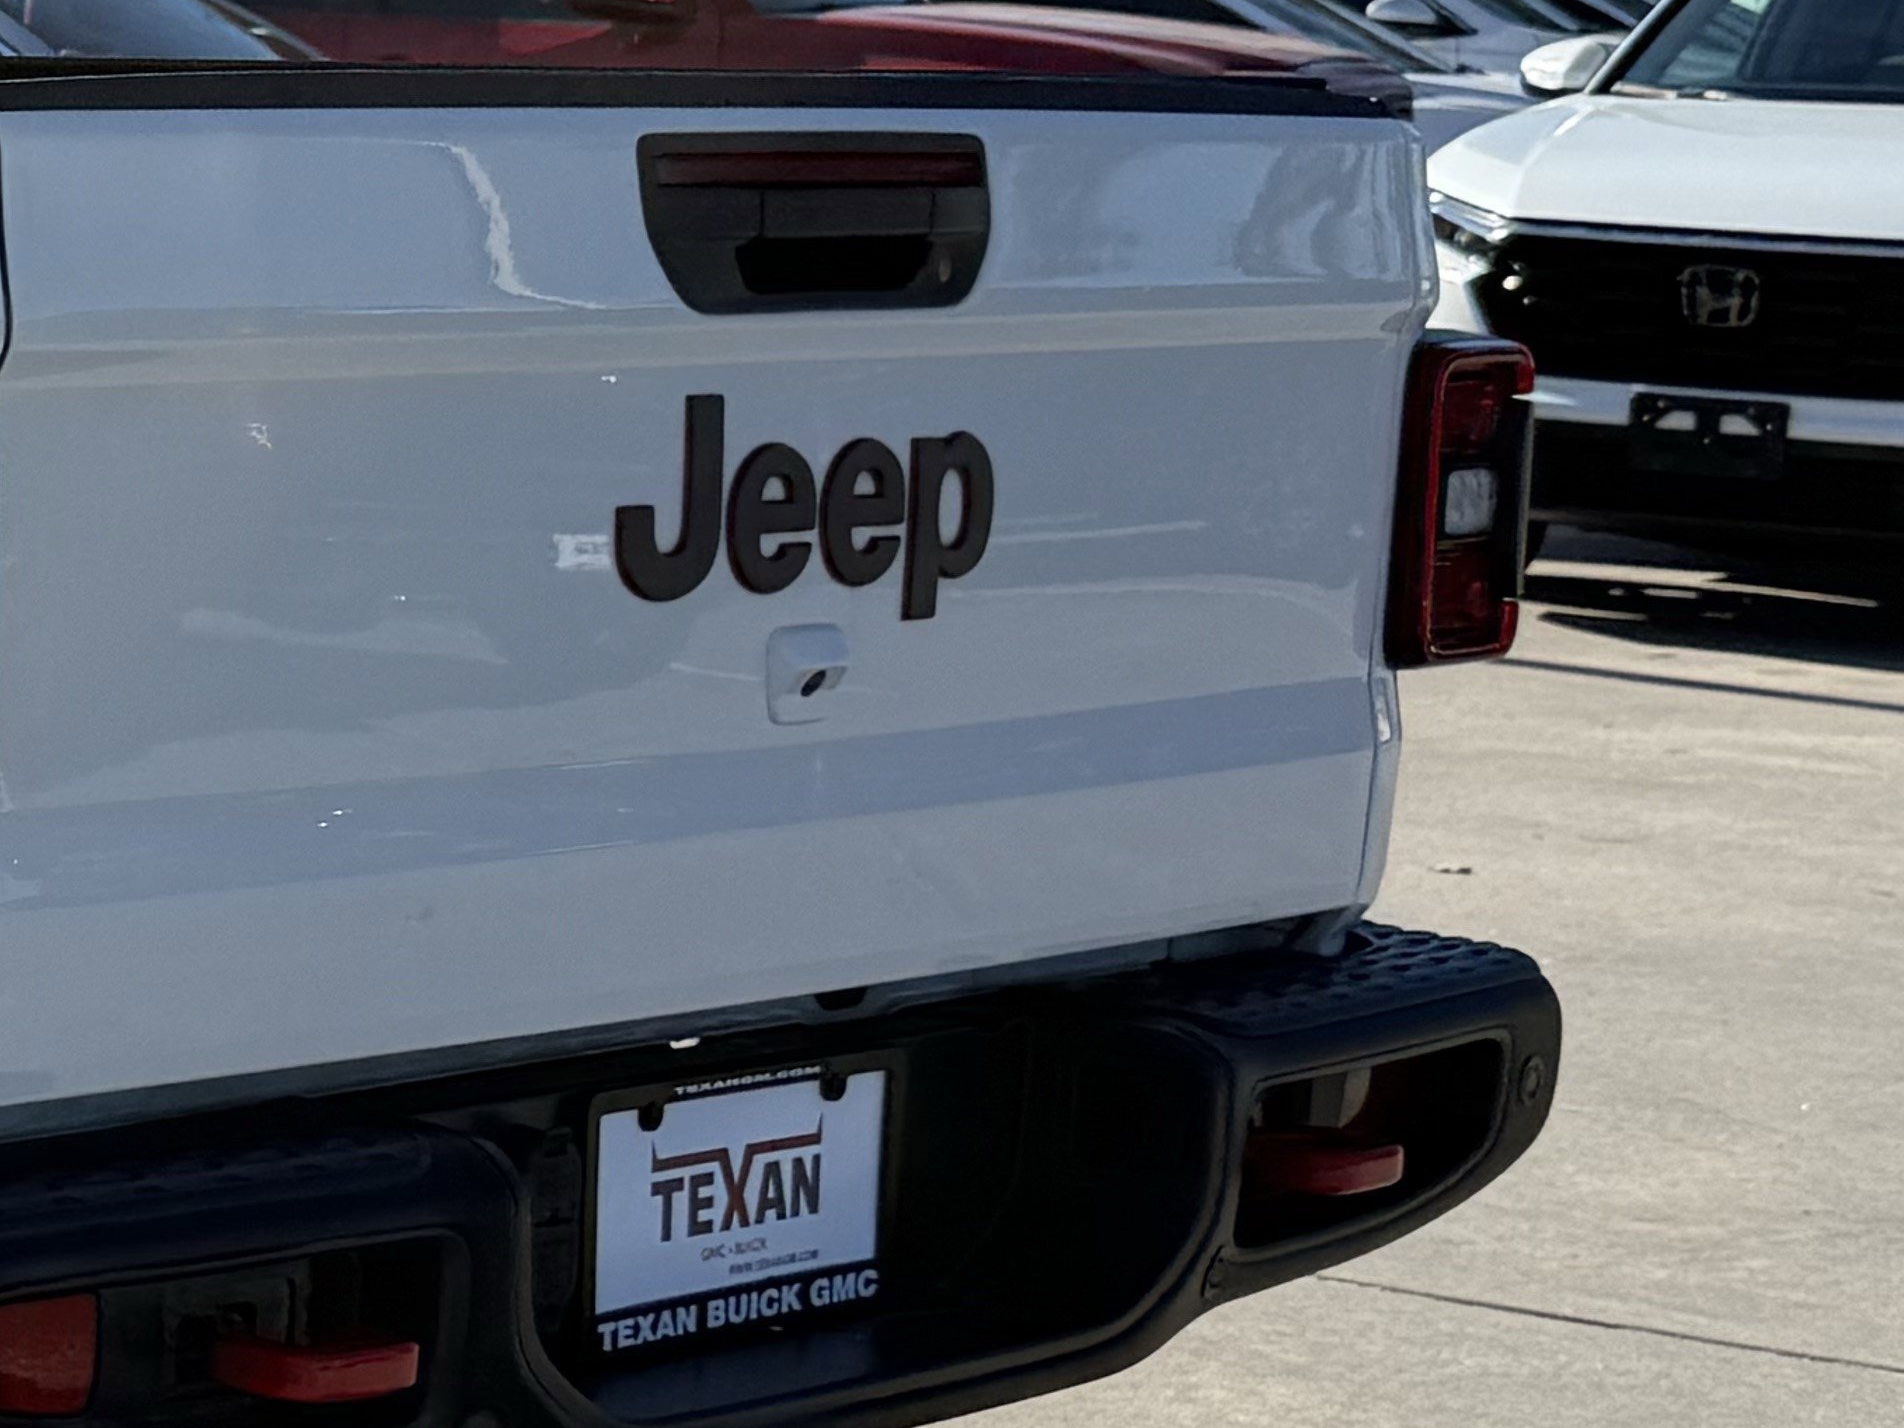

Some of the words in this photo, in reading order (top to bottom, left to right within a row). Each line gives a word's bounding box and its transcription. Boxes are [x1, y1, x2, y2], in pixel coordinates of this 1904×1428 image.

[615, 394, 995, 621] Jeep
[650, 1144, 822, 1243] TEXAN
[597, 1304, 698, 1352] TEXAN
[706, 1283, 803, 1329] BUICK
[809, 1269, 880, 1308] GMC
